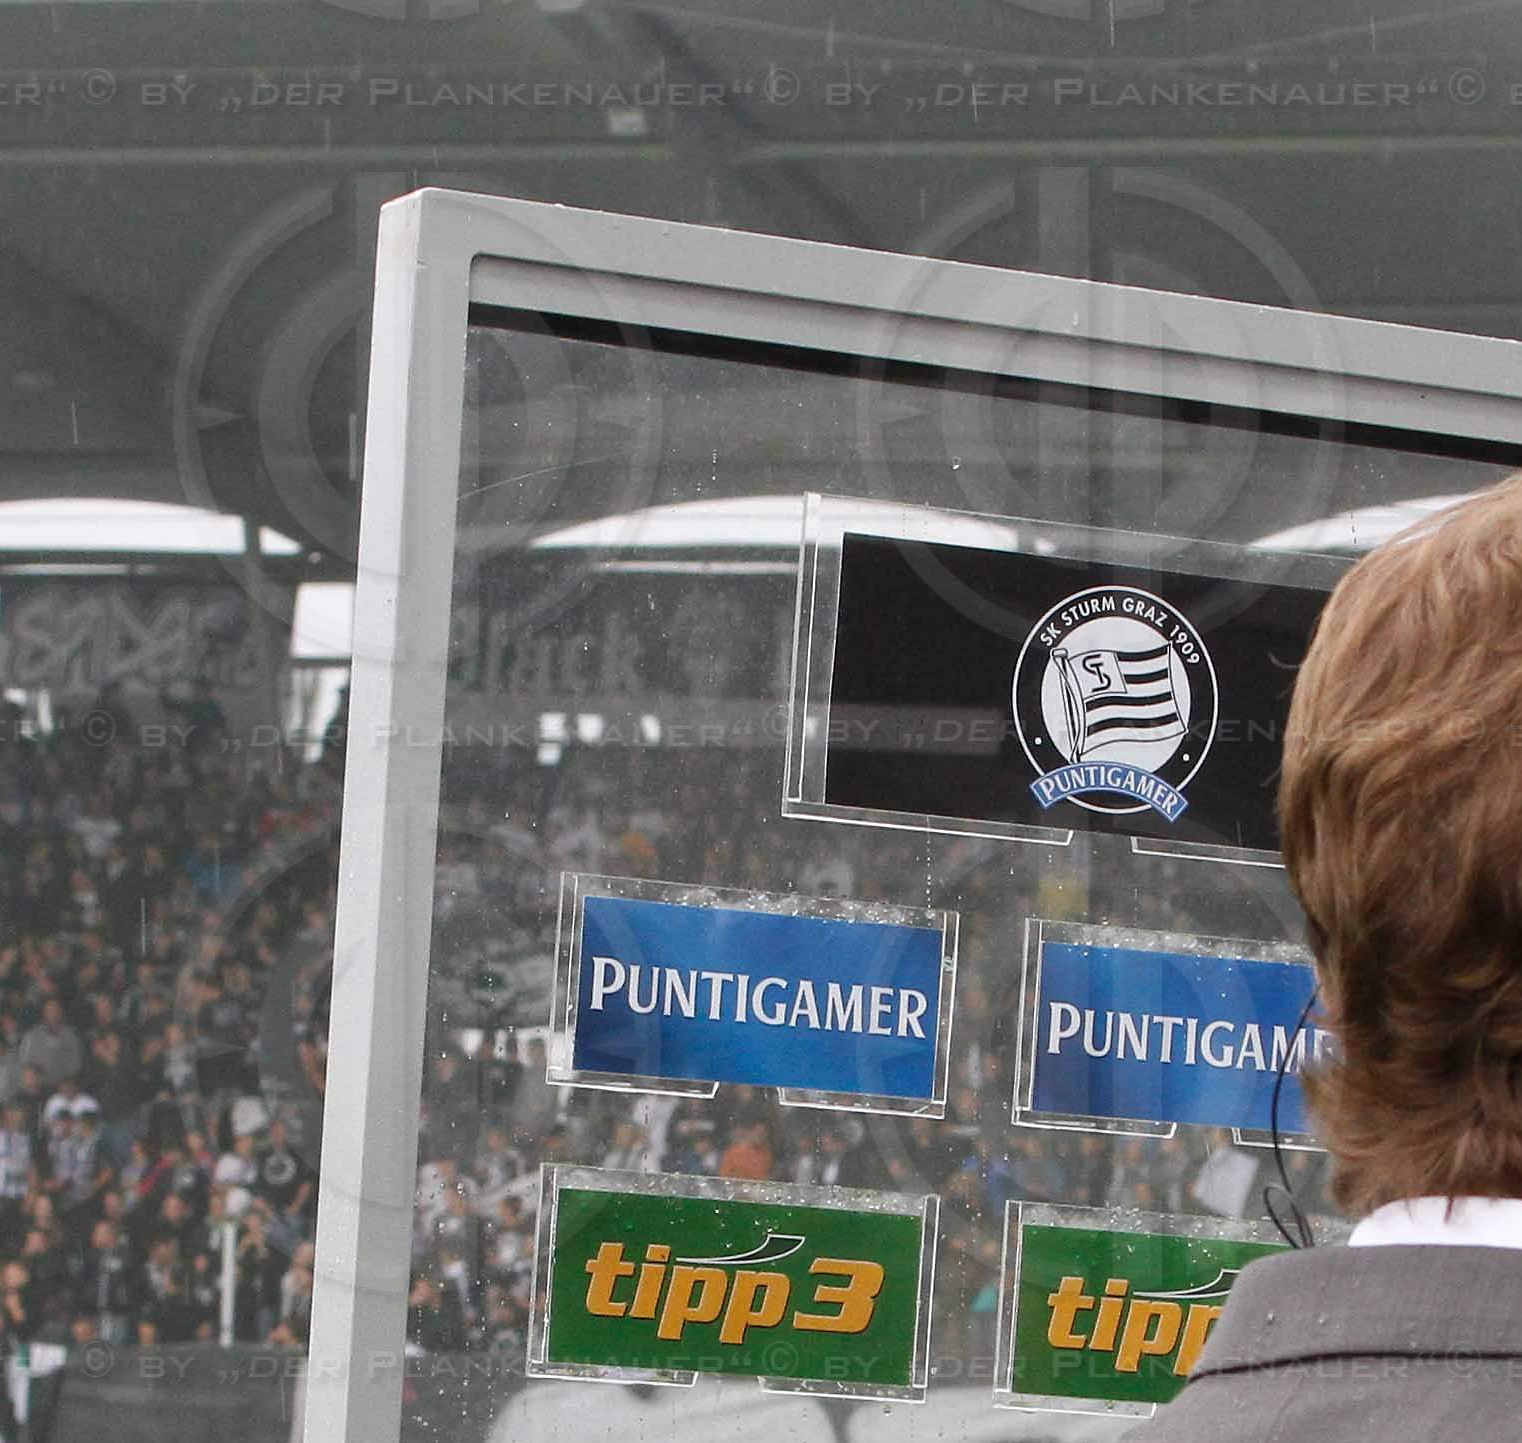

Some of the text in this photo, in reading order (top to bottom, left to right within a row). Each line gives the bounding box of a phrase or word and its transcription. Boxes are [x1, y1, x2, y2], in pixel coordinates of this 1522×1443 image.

[1040, 596, 1199, 664] SK STURM GRAZ 1909
[1039, 766, 1177, 814] PUNTIGAMER
[591, 955, 928, 1040] PUNTIGAMER
[1047, 1276, 1223, 1377] tipp
